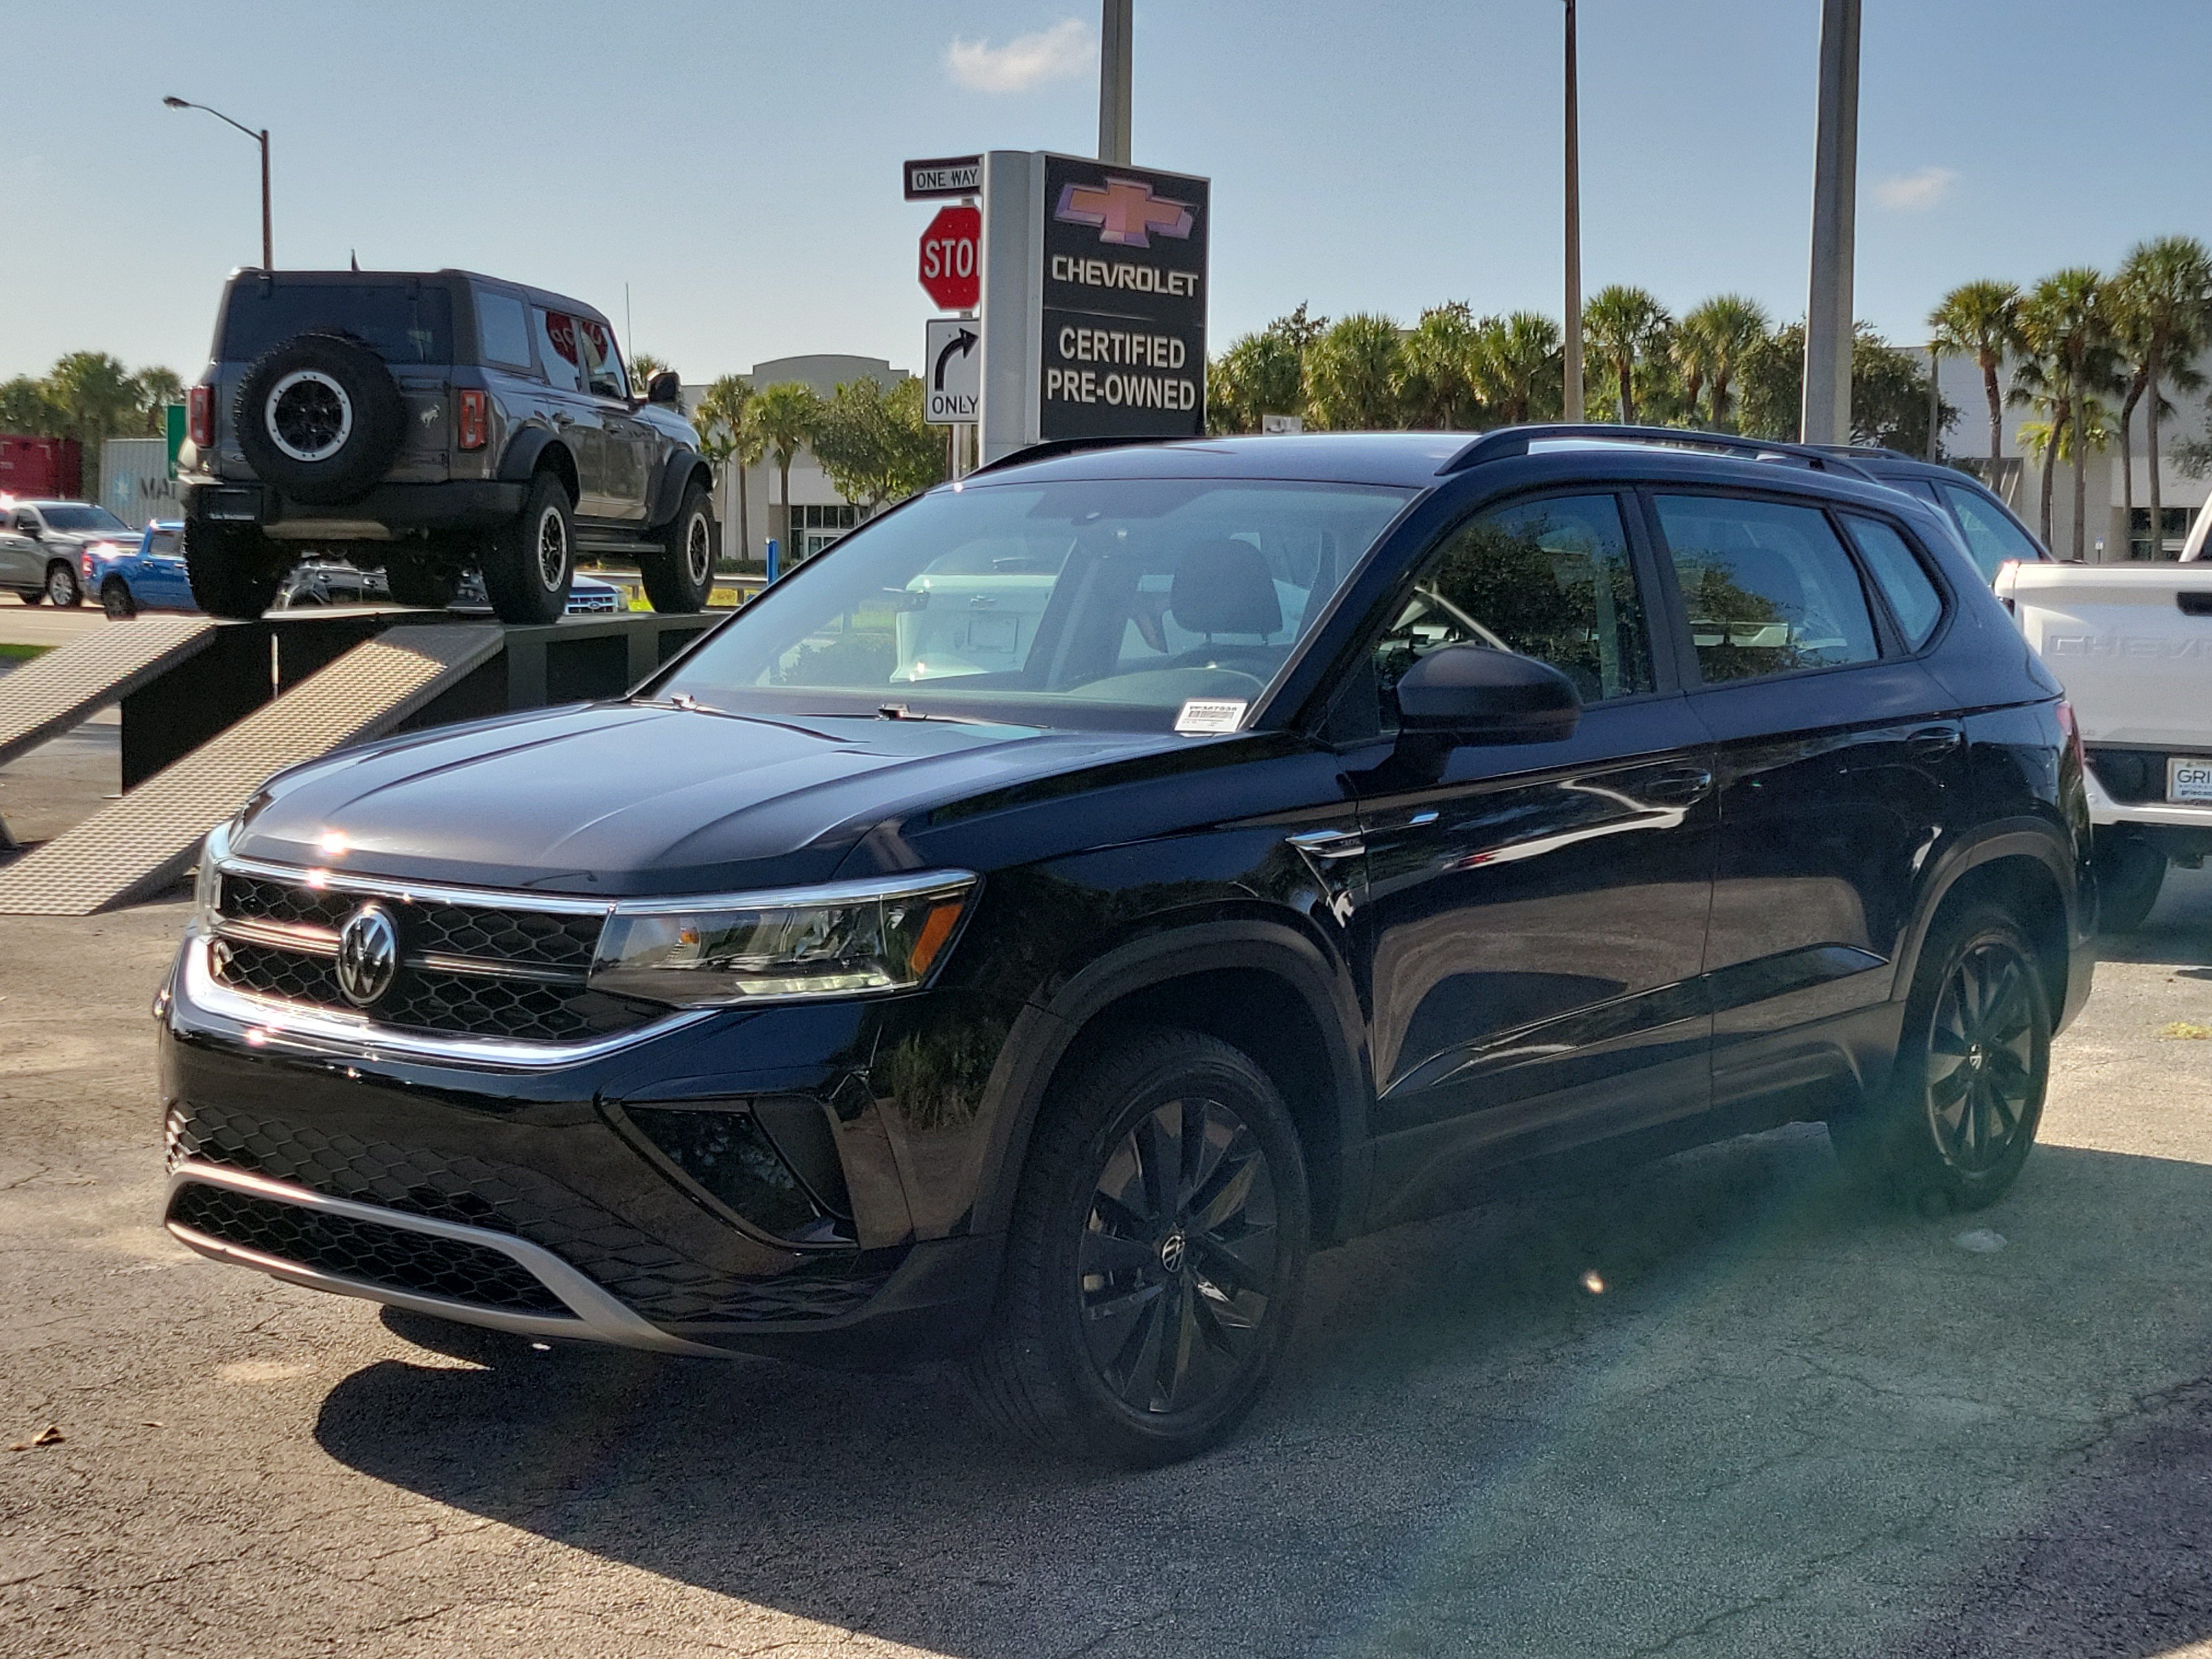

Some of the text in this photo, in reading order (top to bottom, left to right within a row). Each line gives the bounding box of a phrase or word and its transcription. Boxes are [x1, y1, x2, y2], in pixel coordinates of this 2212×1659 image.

[916, 168, 977, 188] ONE WAY
[924, 237, 980, 278] STO
[1052, 255, 1199, 297] CHEVROLET
[1059, 327, 1186, 369] CERTIFIED
[932, 396, 979, 415] ONLY
[1047, 368, 1195, 410] PRE-OWNED
[2177, 769, 2212, 784] GRI
